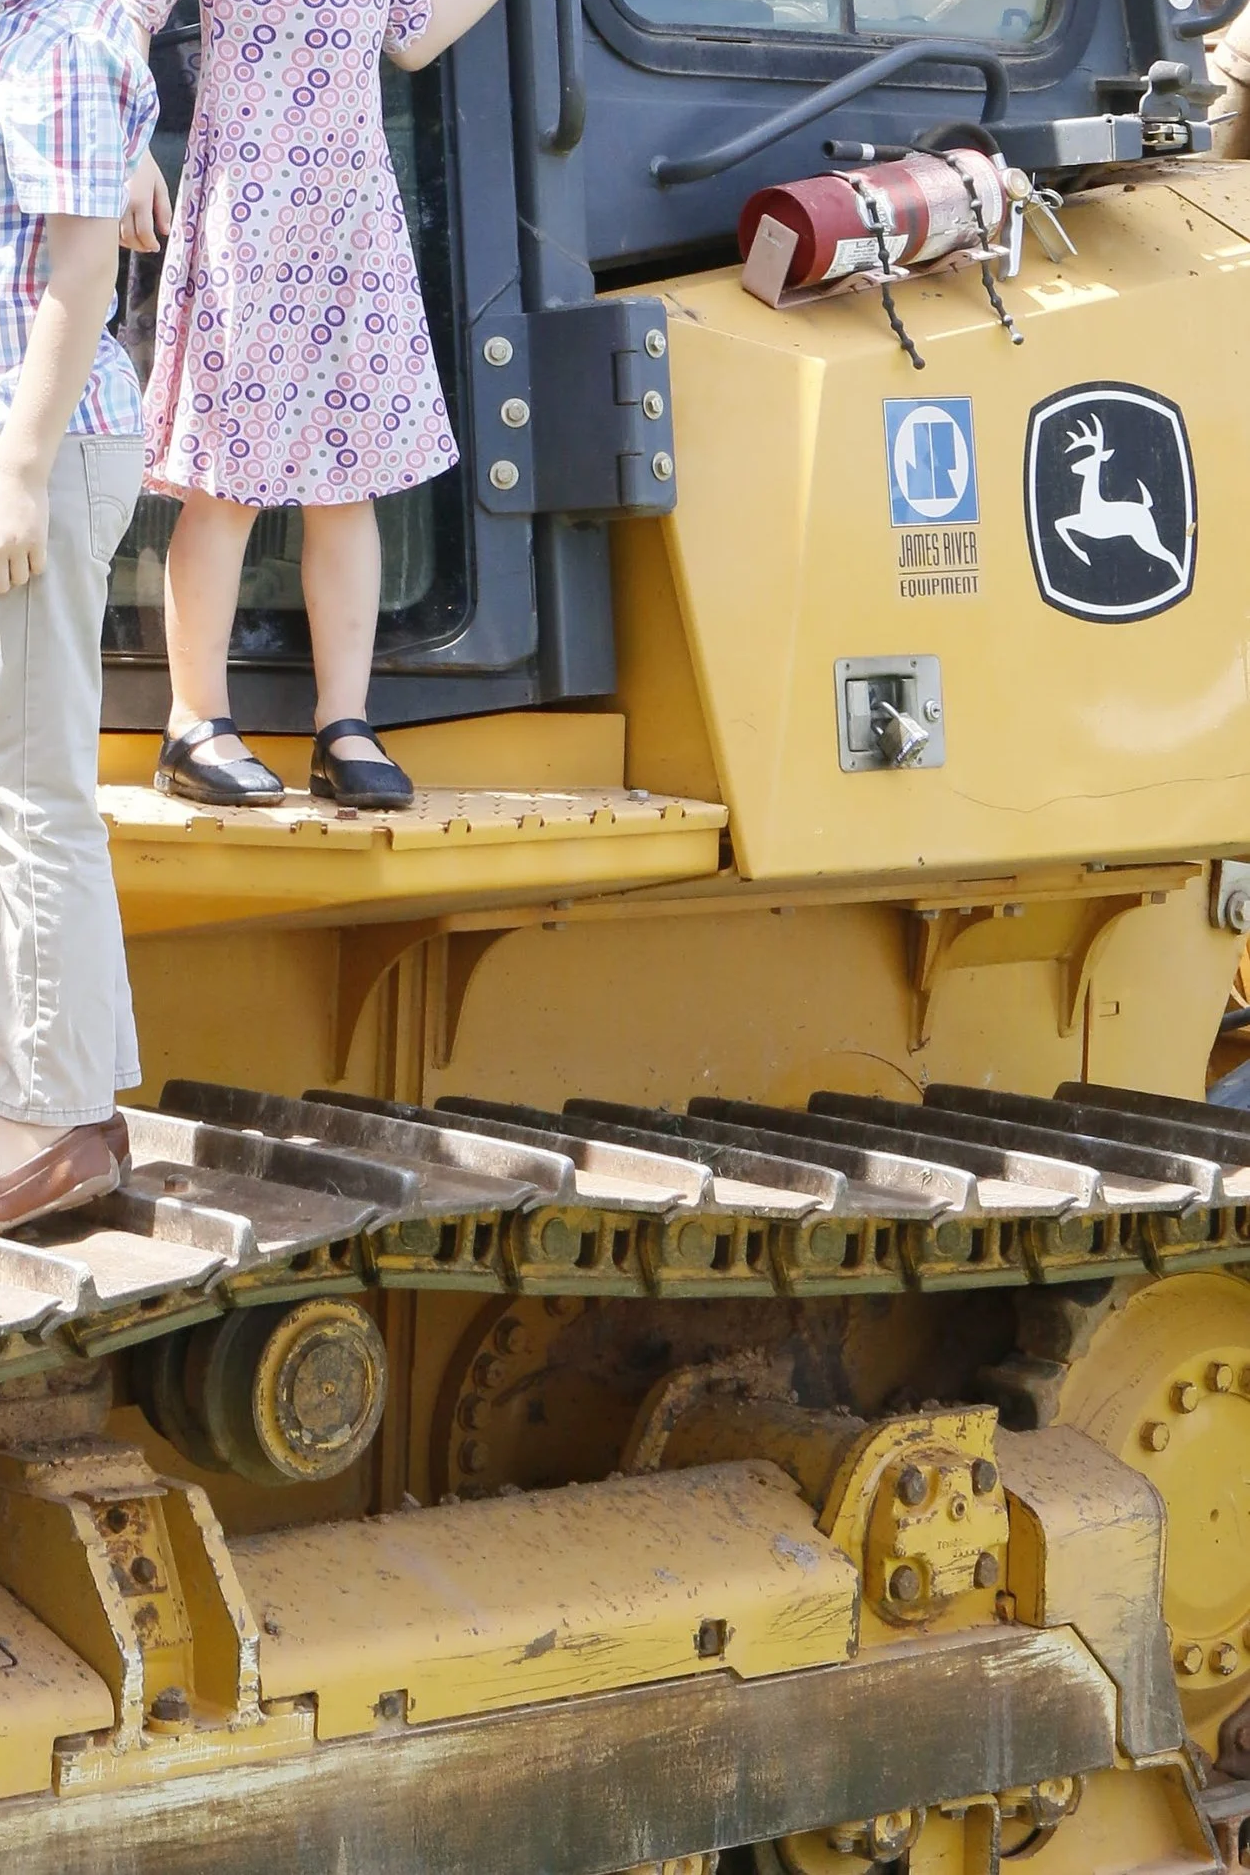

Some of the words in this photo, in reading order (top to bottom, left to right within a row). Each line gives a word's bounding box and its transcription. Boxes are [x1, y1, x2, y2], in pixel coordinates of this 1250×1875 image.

[899, 532, 940, 568] JAMES
[943, 531, 978, 565] RIVER
[900, 575, 979, 598] EQUIPMENT
